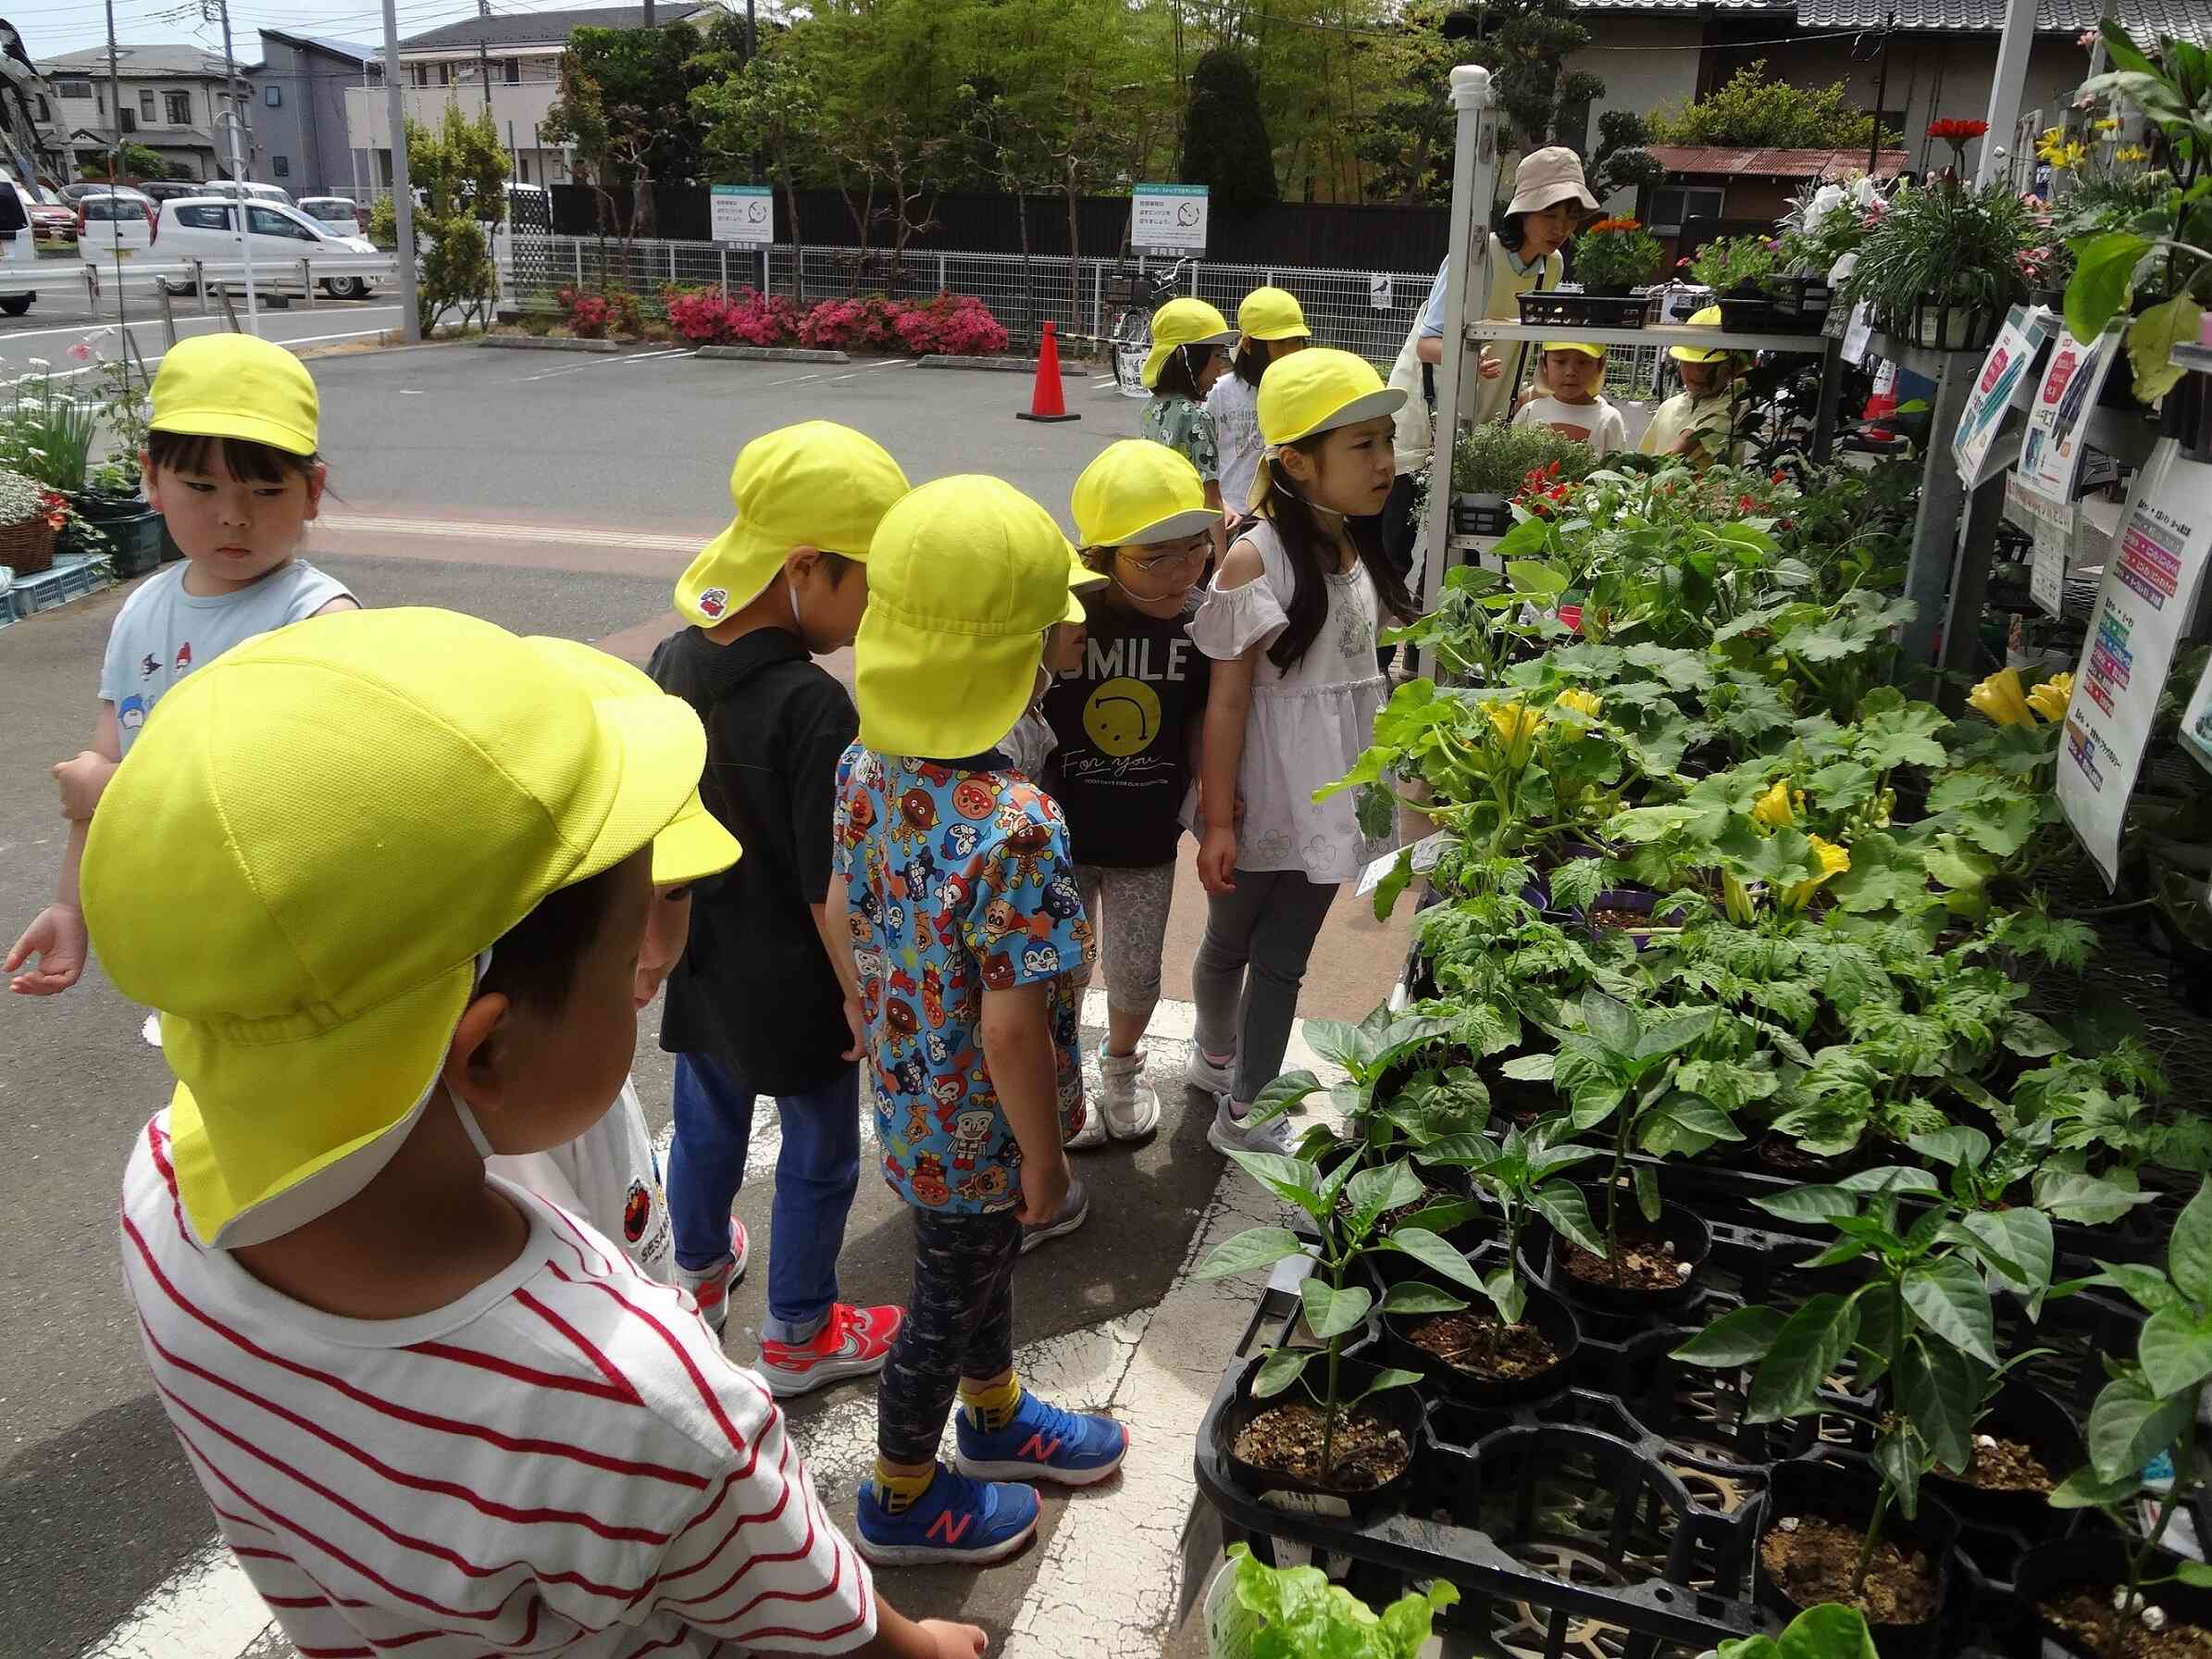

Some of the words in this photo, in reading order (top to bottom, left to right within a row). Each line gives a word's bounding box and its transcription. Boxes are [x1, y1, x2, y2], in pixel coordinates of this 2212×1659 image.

[1062, 749, 1104, 778] For
[1112, 755, 1162, 778] you
[926, 1510, 972, 1544] N
